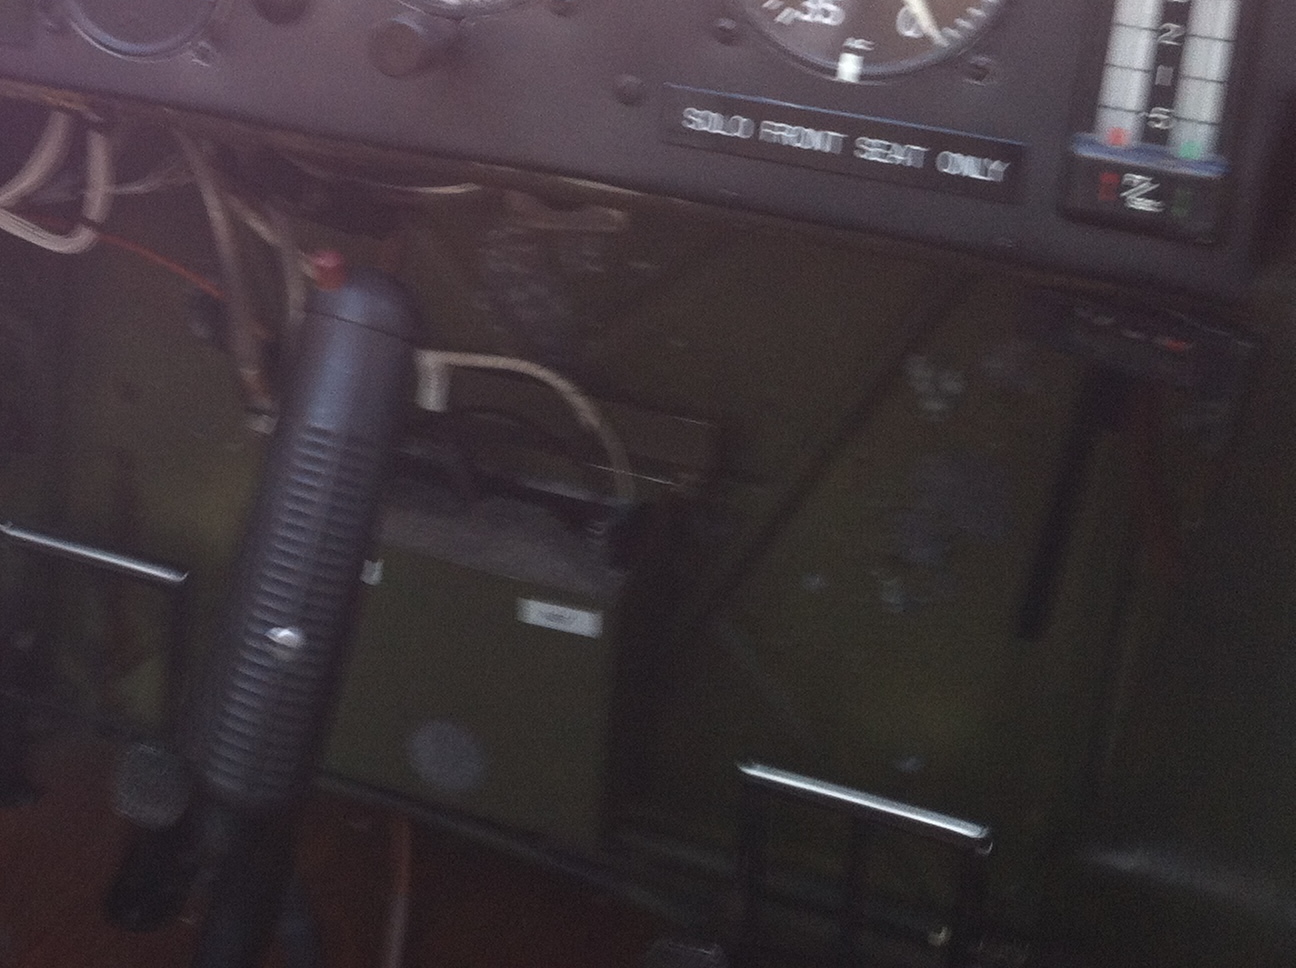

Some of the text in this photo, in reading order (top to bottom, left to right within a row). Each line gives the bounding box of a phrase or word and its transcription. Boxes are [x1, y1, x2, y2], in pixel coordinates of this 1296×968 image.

[1157, 23, 1185, 46] 2
[681, 107, 1010, 182] SOLO FRONT SEAT ONLY
